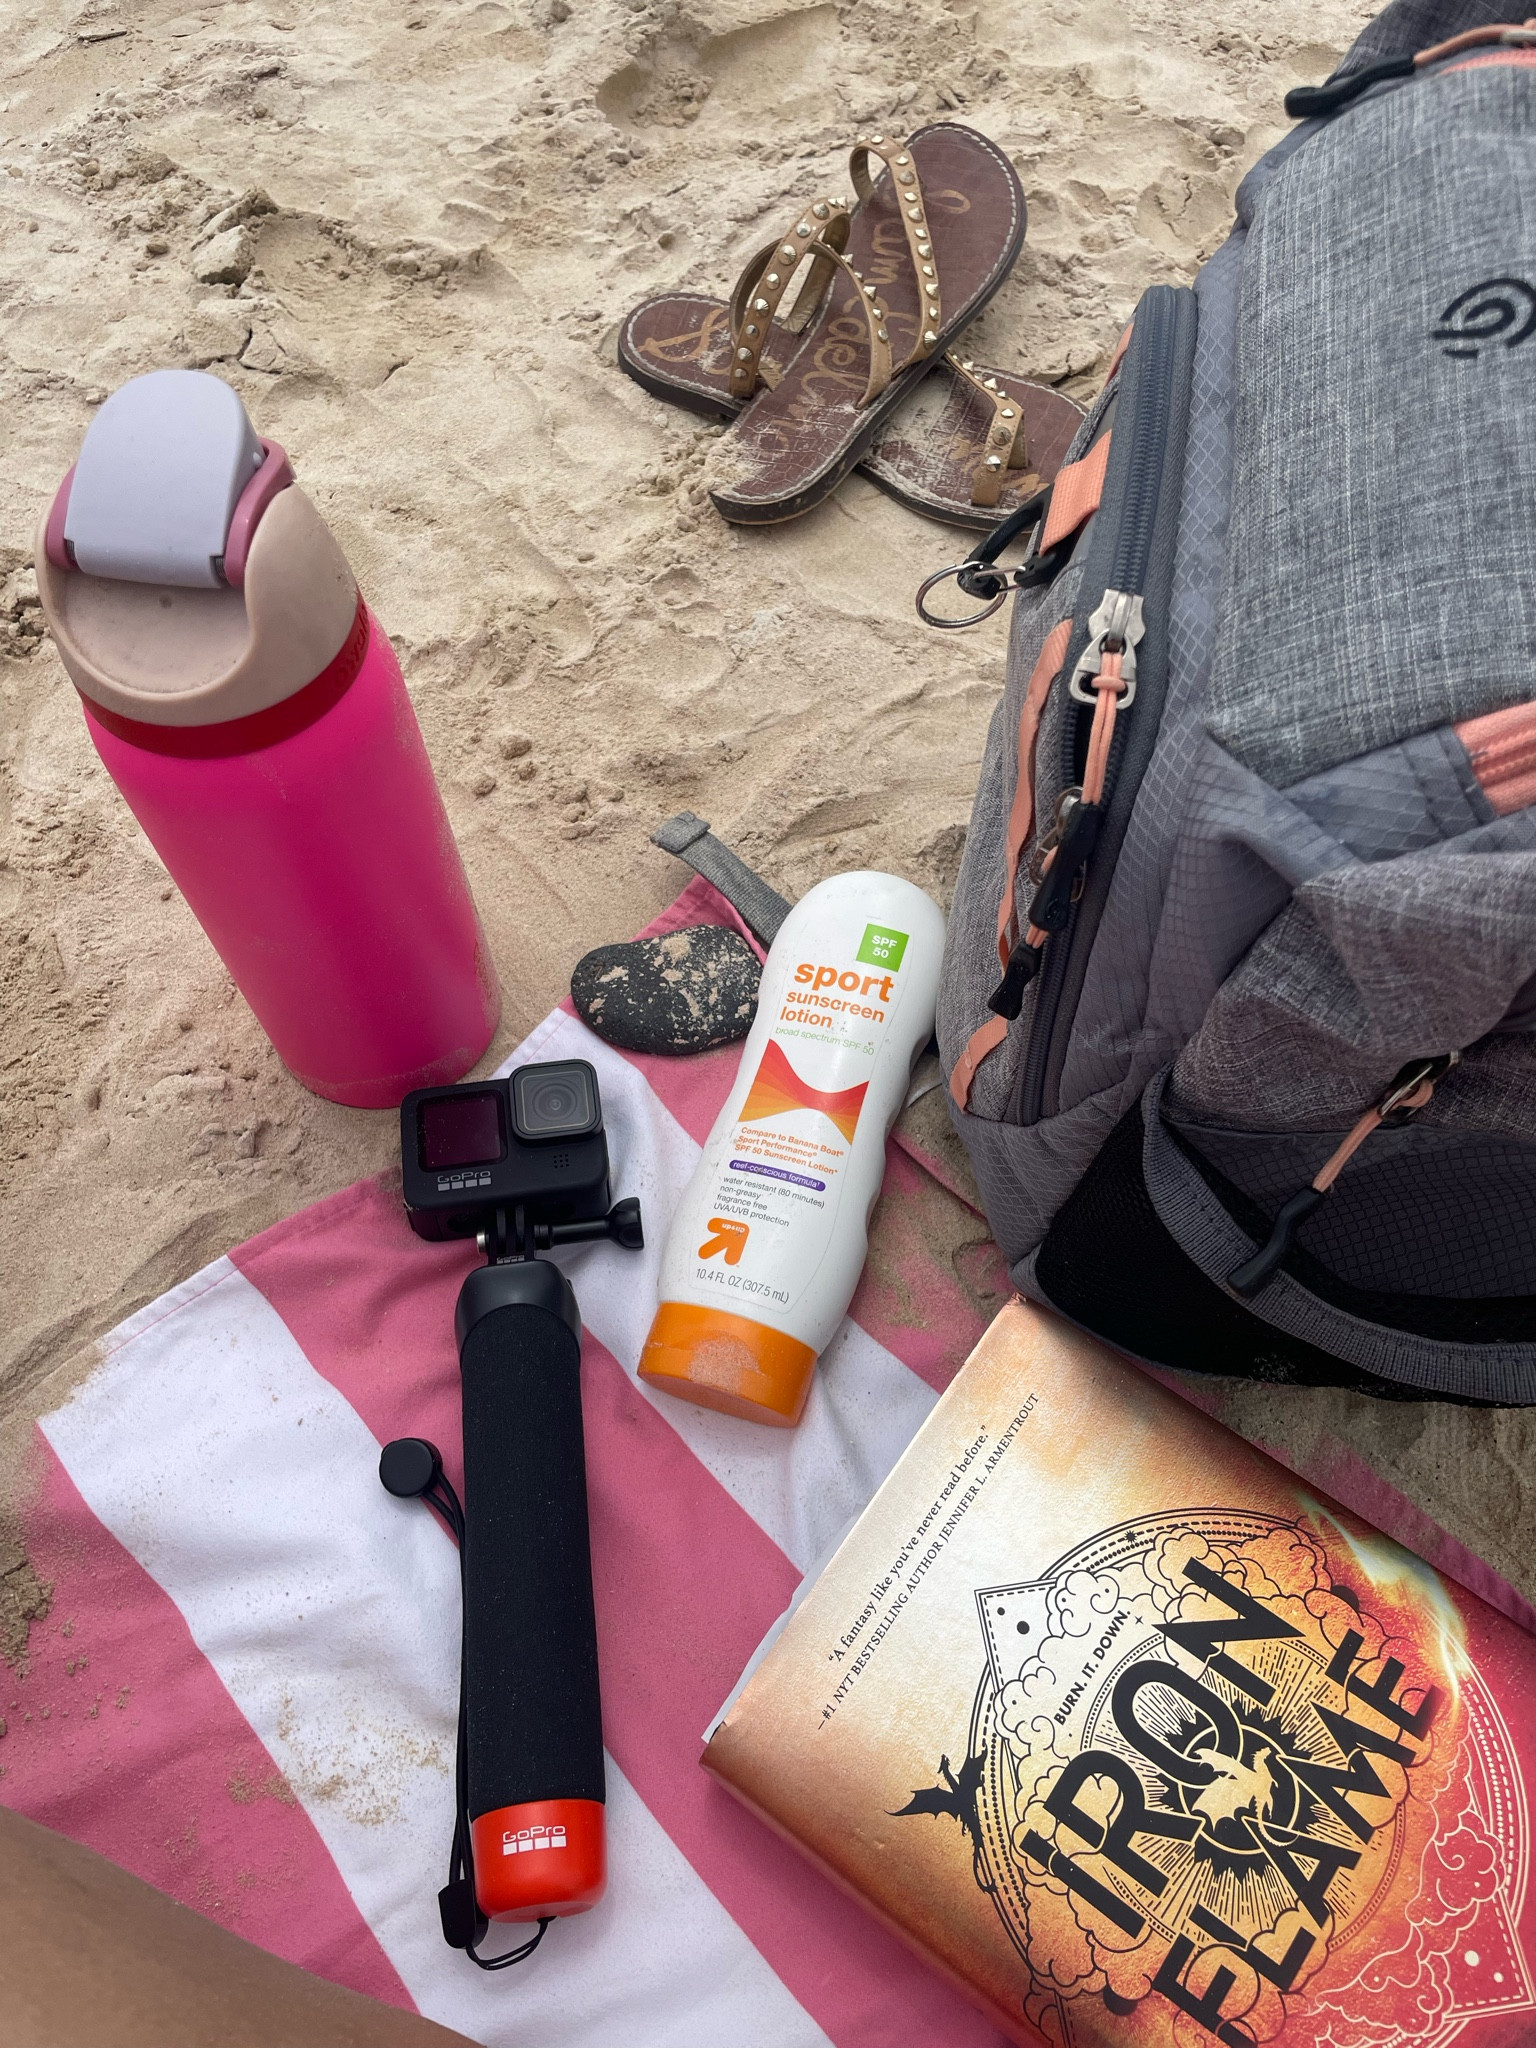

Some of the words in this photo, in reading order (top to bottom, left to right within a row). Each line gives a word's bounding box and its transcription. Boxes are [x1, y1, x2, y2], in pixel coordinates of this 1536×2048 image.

[871, 935, 898, 948] SPF
[872, 947, 890, 959] 50
[794, 963, 895, 1003] sport
[780, 1006, 833, 1028] lotion
[786, 991, 885, 1023] sunscreen
[775, 1027, 800, 1037] broad
[800, 1030, 841, 1045] spectrum
[842, 1040, 862, 1050] SPF
[862, 1046, 875, 1056] 50
[738, 1135, 759, 1146] Sport
[741, 1127, 776, 1140] Compare
[787, 1136, 819, 1150] Banana
[735, 1143, 751, 1152] SPF
[752, 1146, 762, 1155] 50
[763, 1149, 807, 1166] Sunscreen
[437, 1170, 491, 1184] GoPro
[733, 1161, 788, 1179] reef-conscious
[716, 1193, 752, 1209] fragrance
[752, 1201, 767, 1211] free
[719, 1185, 761, 1200] non-greasy
[723, 1176, 743, 1186] water
[744, 1180, 777, 1194] resistant
[778, 1187, 791, 1197] (80
[792, 1192, 825, 1209] minutes)
[713, 1202, 749, 1216] UVA/UVB
[749, 1211, 790, 1227] protection
[696, 1268, 714, 1280] 10.4
[715, 1271, 725, 1284] FL
[727, 1275, 742, 1287] OZ
[742, 1278, 771, 1297] (307.5
[771, 1290, 790, 1304] mL)
[833, 1673, 855, 1704] NYT
[850, 1592, 909, 1676] BESTSELLING
[907, 1533, 944, 1594] AUTHOR
[941, 1483, 980, 1543] JENNIFER
[975, 1475, 988, 1486] L.
[984, 1392, 1039, 1474] ARMENTROUT
[840, 1600, 877, 1649] fantasy
[870, 1576, 893, 1602] like
[916, 1501, 942, 1537] never
[939, 1471, 961, 1502] read
[1053, 1681, 1088, 1726] BURN.
[1081, 1662, 1099, 1679] IT.
[1092, 1610, 1131, 1661] DOWN.
[1018, 1556, 1307, 1940] IRON
[502, 1825, 566, 1843] GoPro
[1151, 1628, 1446, 2048] FLAME
